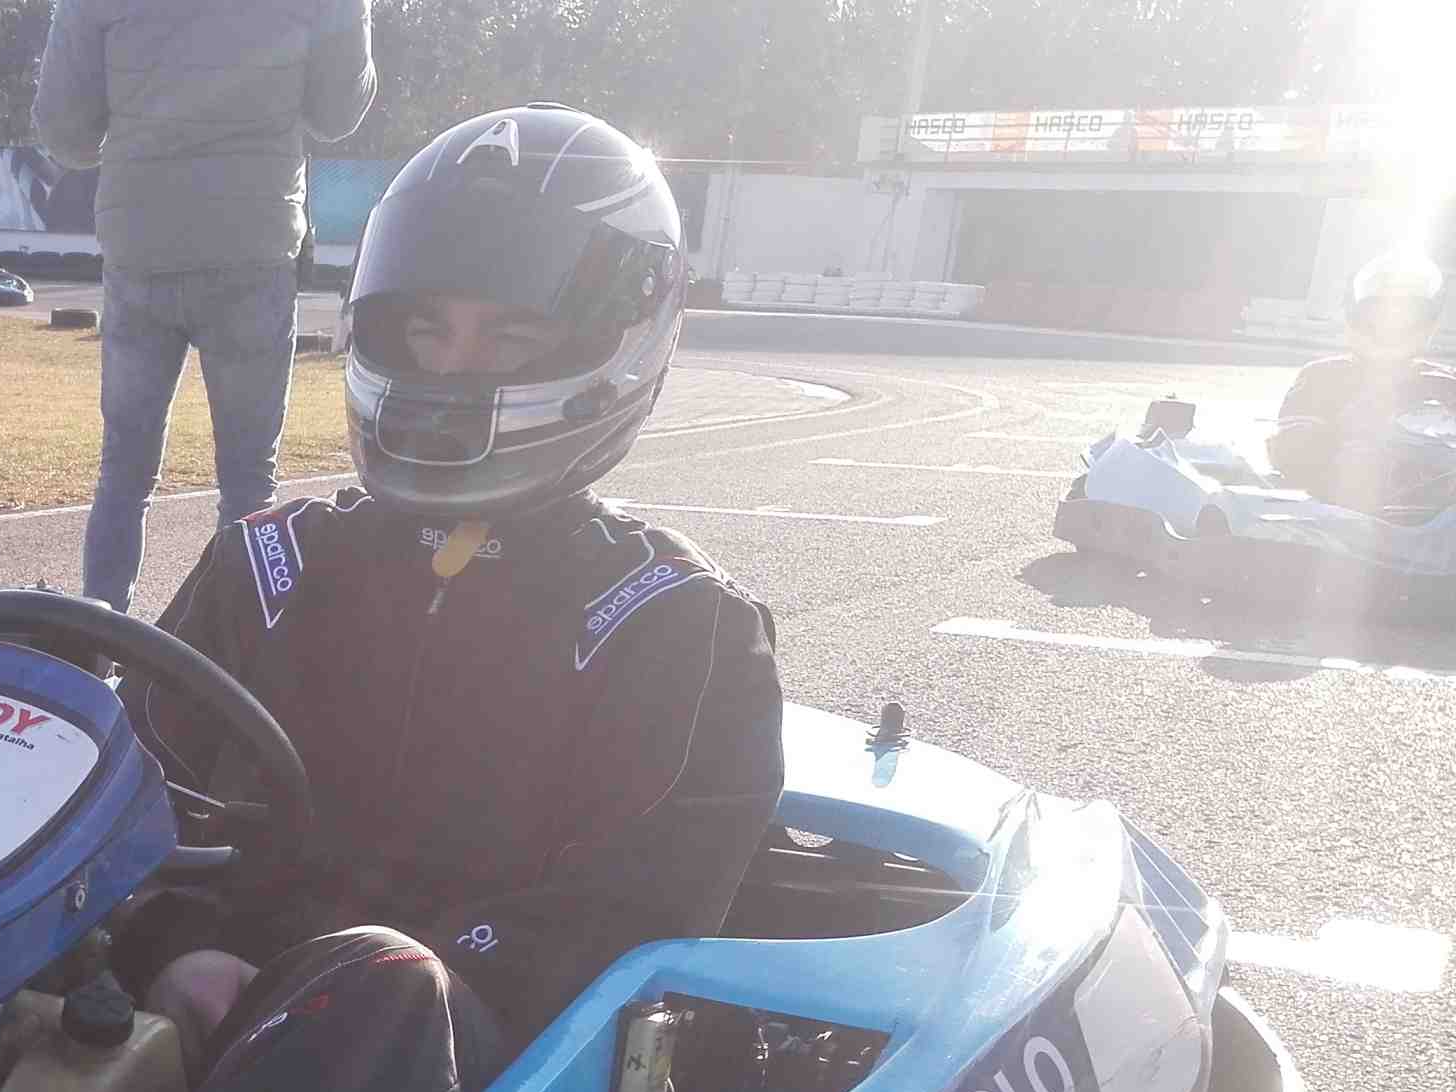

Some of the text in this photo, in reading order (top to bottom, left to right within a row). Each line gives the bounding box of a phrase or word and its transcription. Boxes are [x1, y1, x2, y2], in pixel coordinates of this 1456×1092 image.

[1035, 115, 1102, 132] HASCO
[256, 522, 294, 594] sparco
[586, 563, 676, 632] sparco
